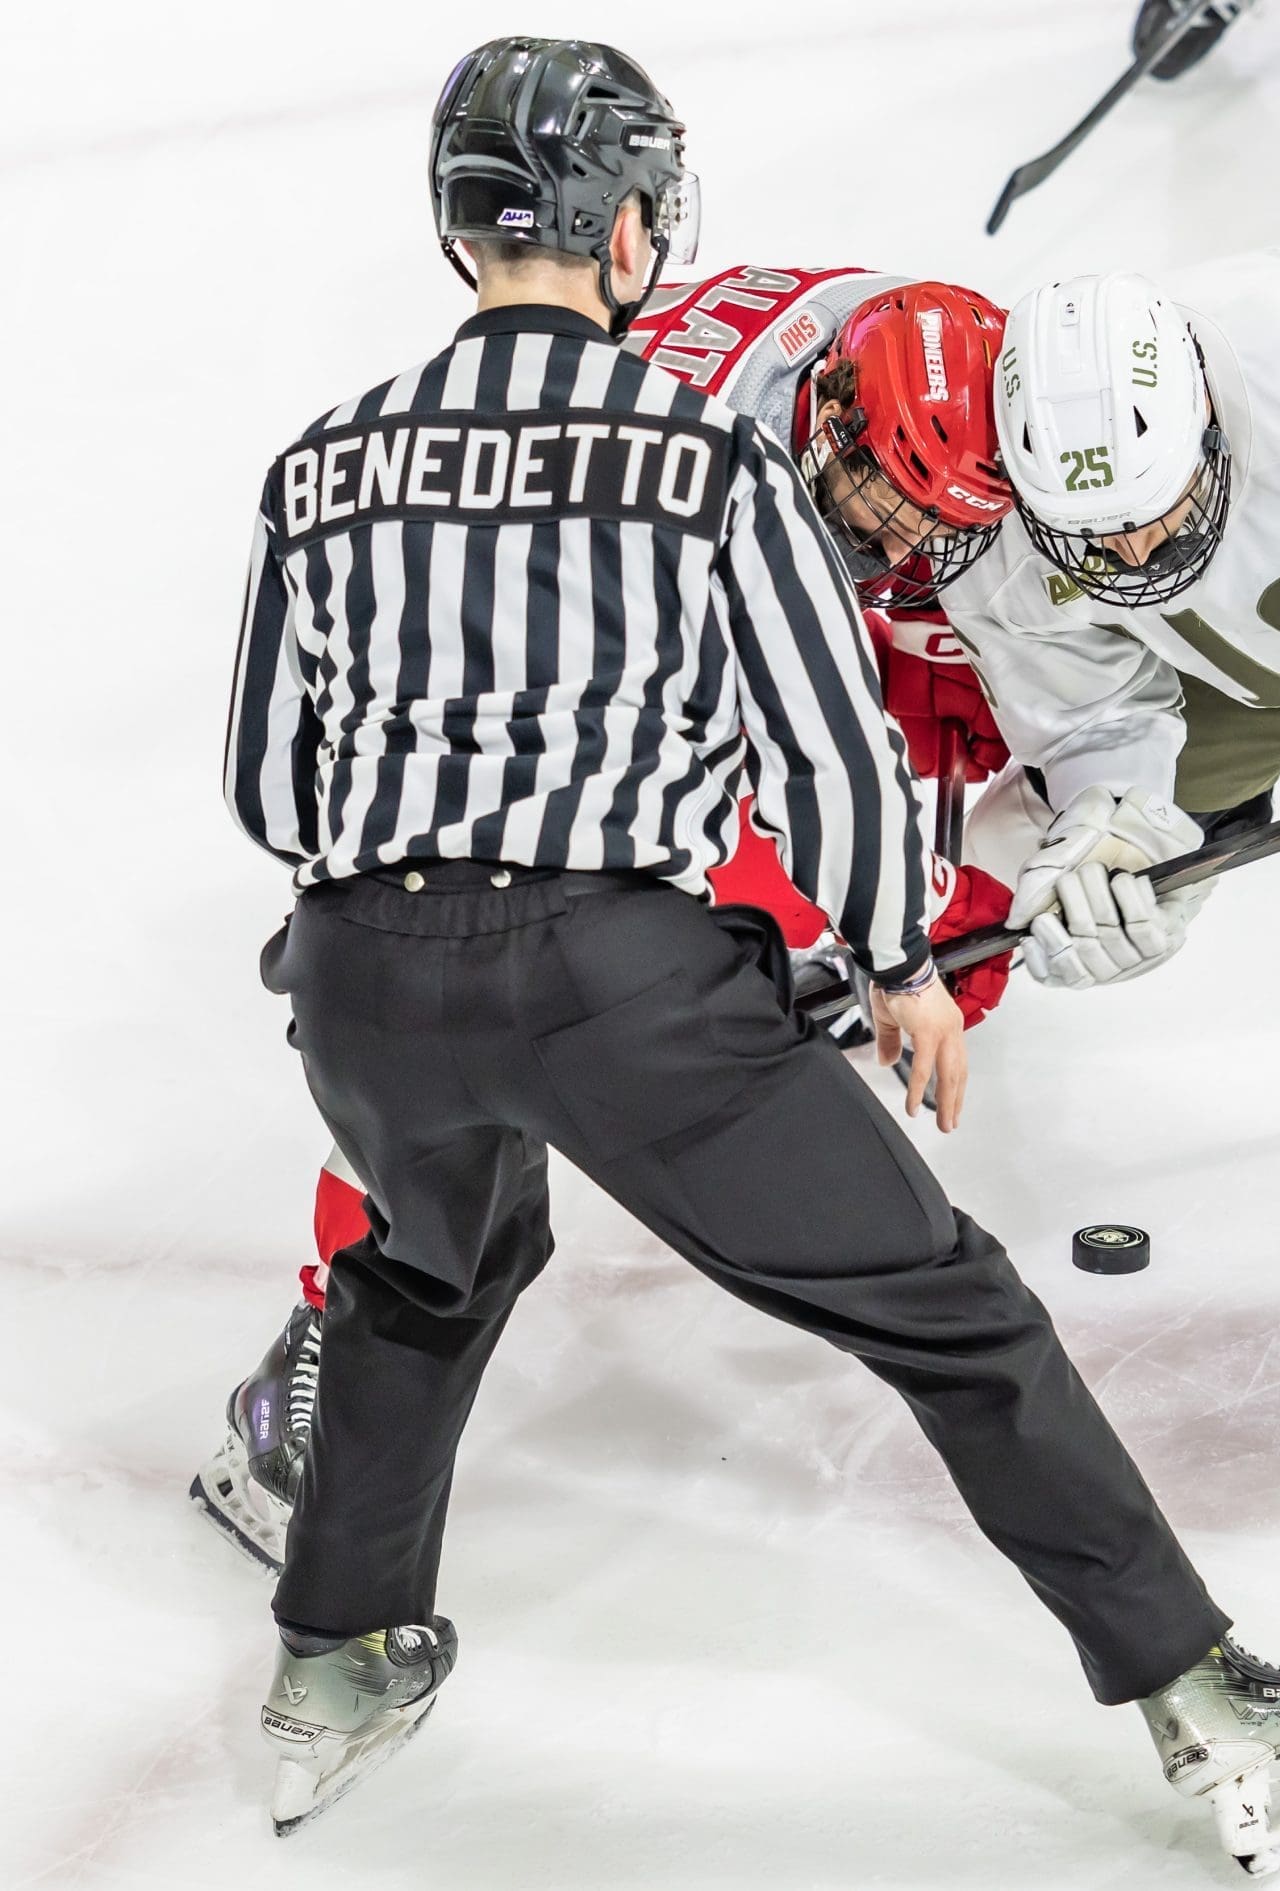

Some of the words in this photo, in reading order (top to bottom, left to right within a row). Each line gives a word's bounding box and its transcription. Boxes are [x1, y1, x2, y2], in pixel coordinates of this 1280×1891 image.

[649, 265, 828, 388] ALAT
[779, 314, 820, 357] SHU
[1131, 337, 1158, 389] U.S.
[284, 423, 712, 538] BENEDETTO
[1060, 446, 1114, 491] 25
[947, 484, 1003, 511] CCM
[263, 1716, 315, 1739] BAUER
[1166, 1748, 1208, 1778] BAUER
